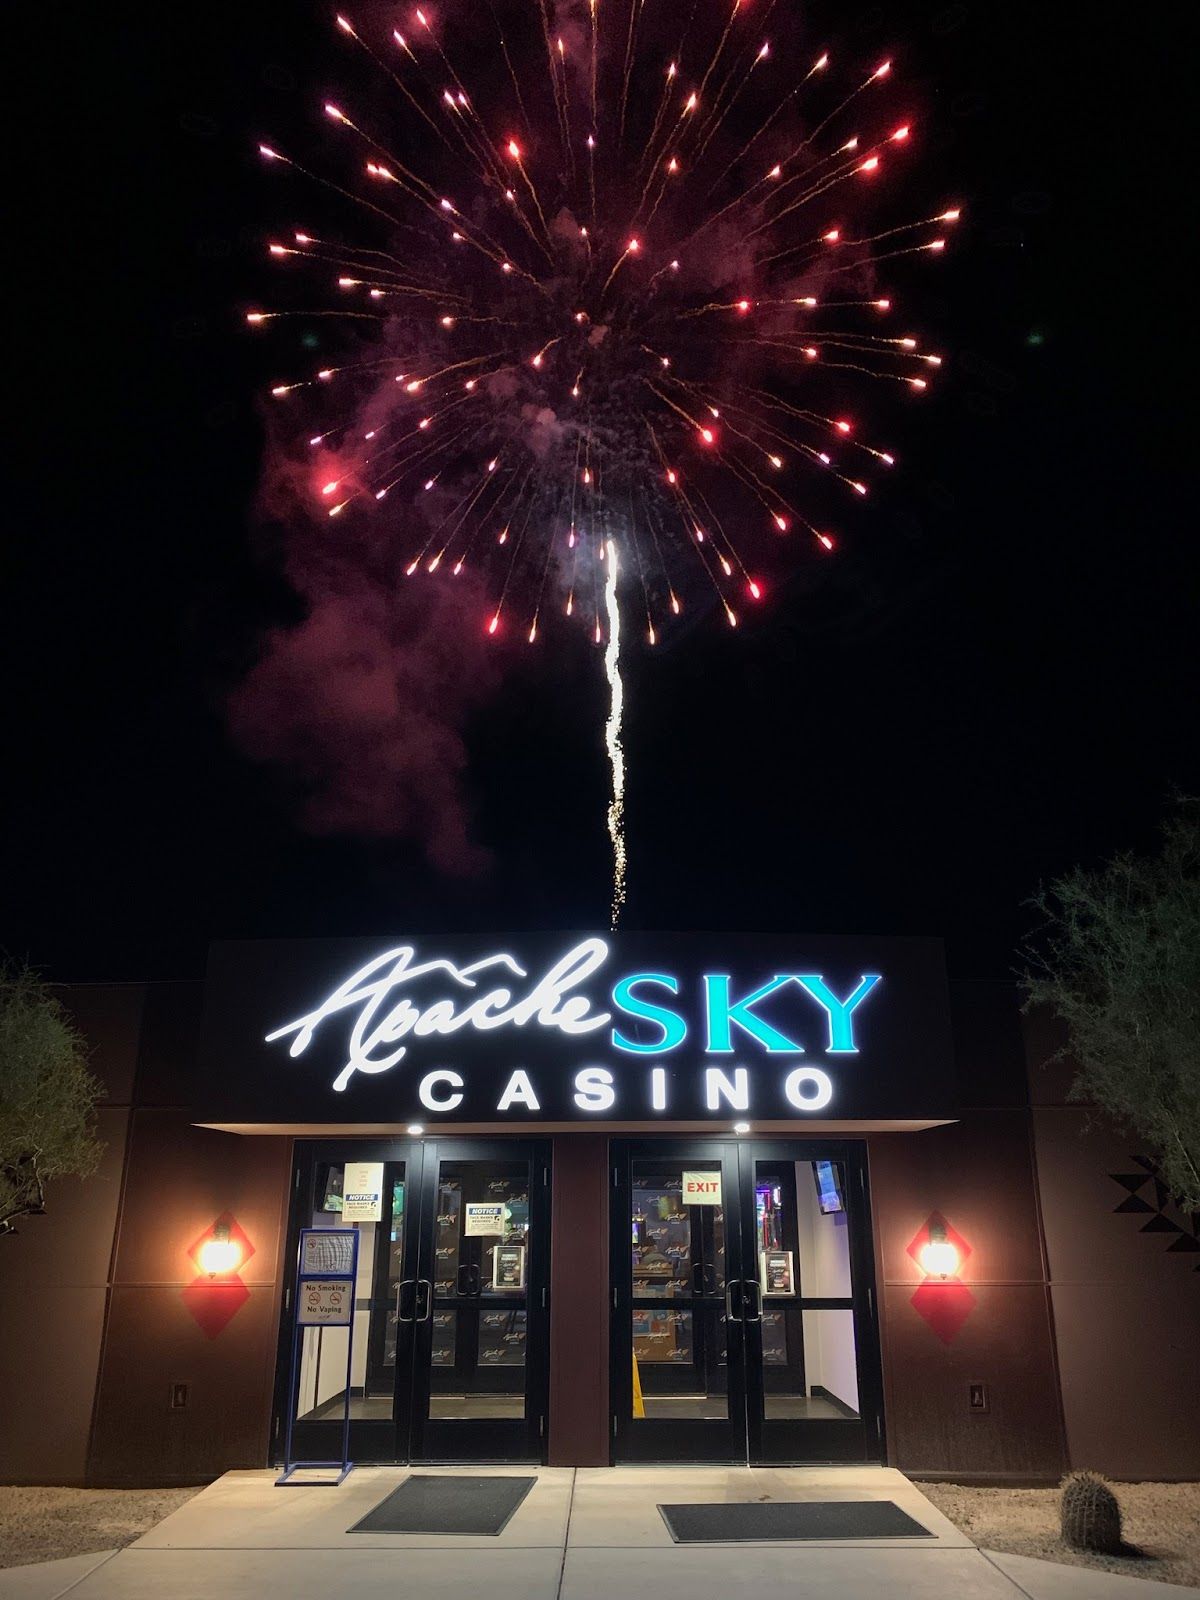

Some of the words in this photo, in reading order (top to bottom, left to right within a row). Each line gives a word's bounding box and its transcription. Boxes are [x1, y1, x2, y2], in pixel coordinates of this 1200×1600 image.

[265, 937, 611, 1093] Apache
[611, 973, 882, 1055] SKY
[418, 1066, 834, 1112] CASINO
[687, 1182, 719, 1192] EXIT
